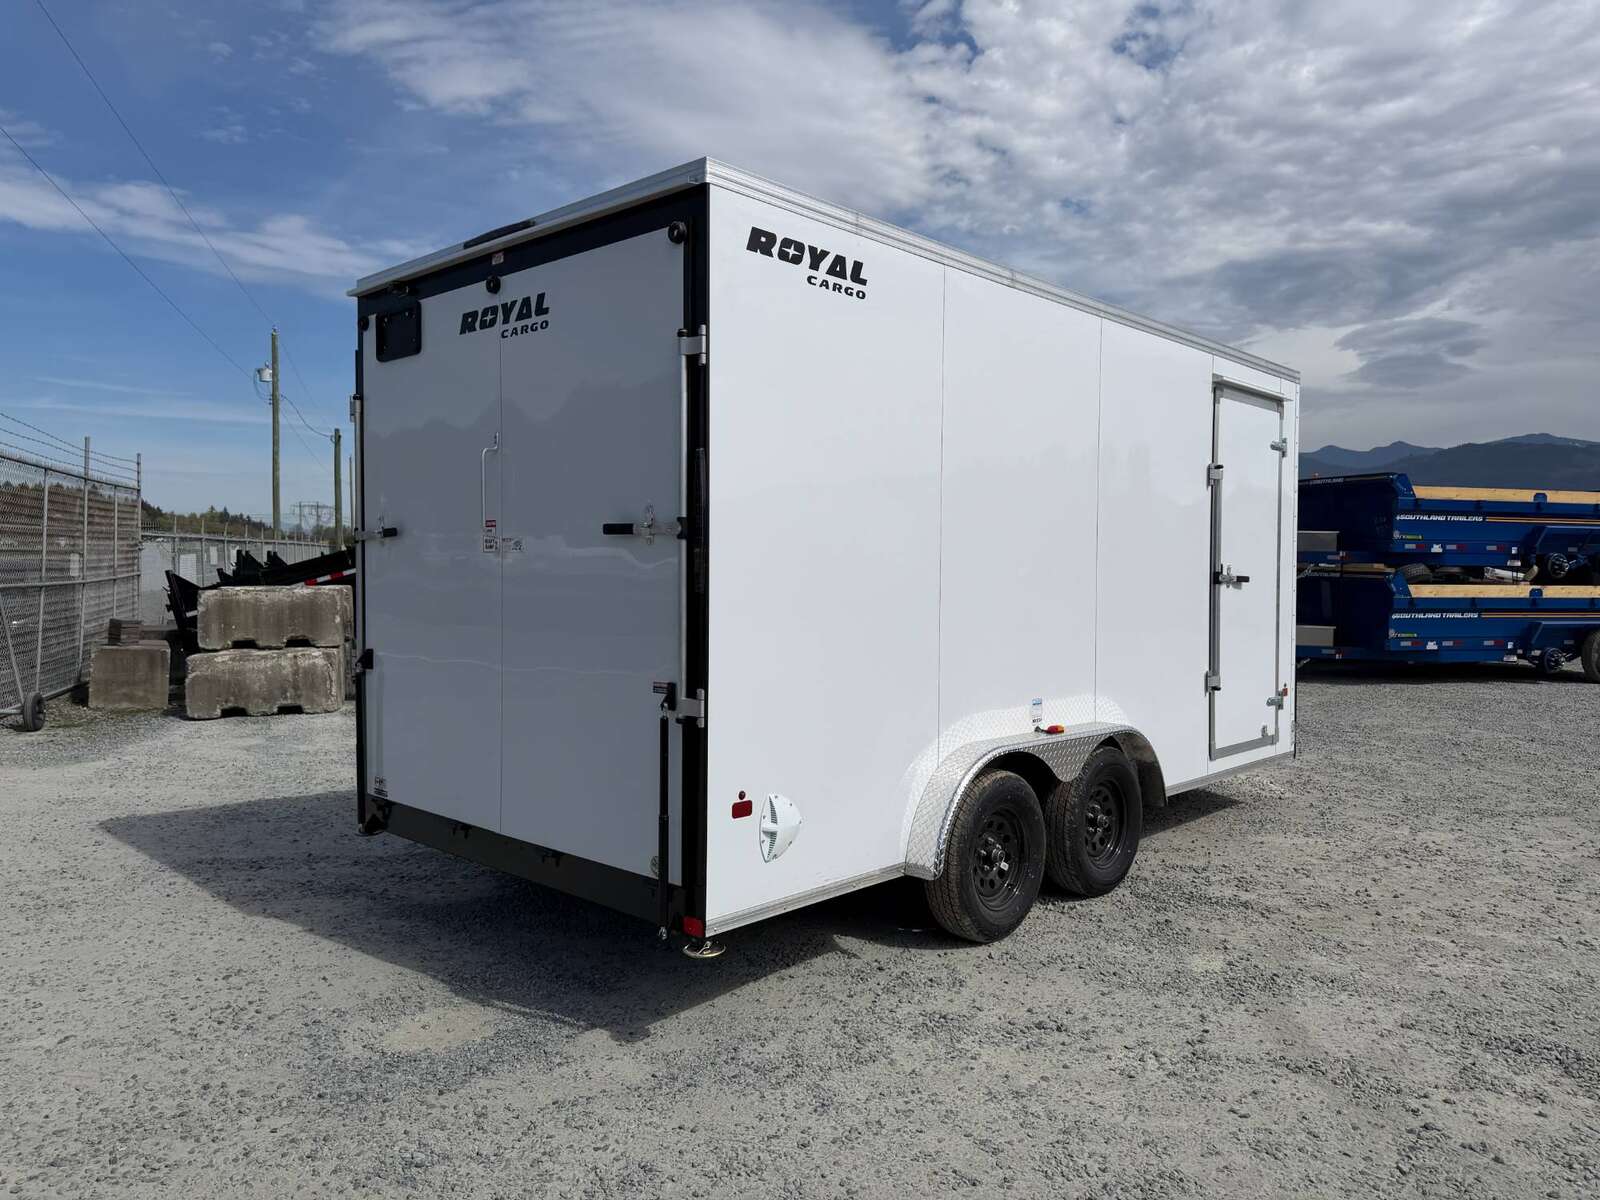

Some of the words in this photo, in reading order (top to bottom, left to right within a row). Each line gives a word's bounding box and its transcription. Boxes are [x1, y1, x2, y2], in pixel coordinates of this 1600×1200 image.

[746, 226, 868, 286] ROYAL
[806, 275, 866, 300] CARGO
[459, 292, 550, 335] ROYAL
[501, 320, 549, 339] CARGO
